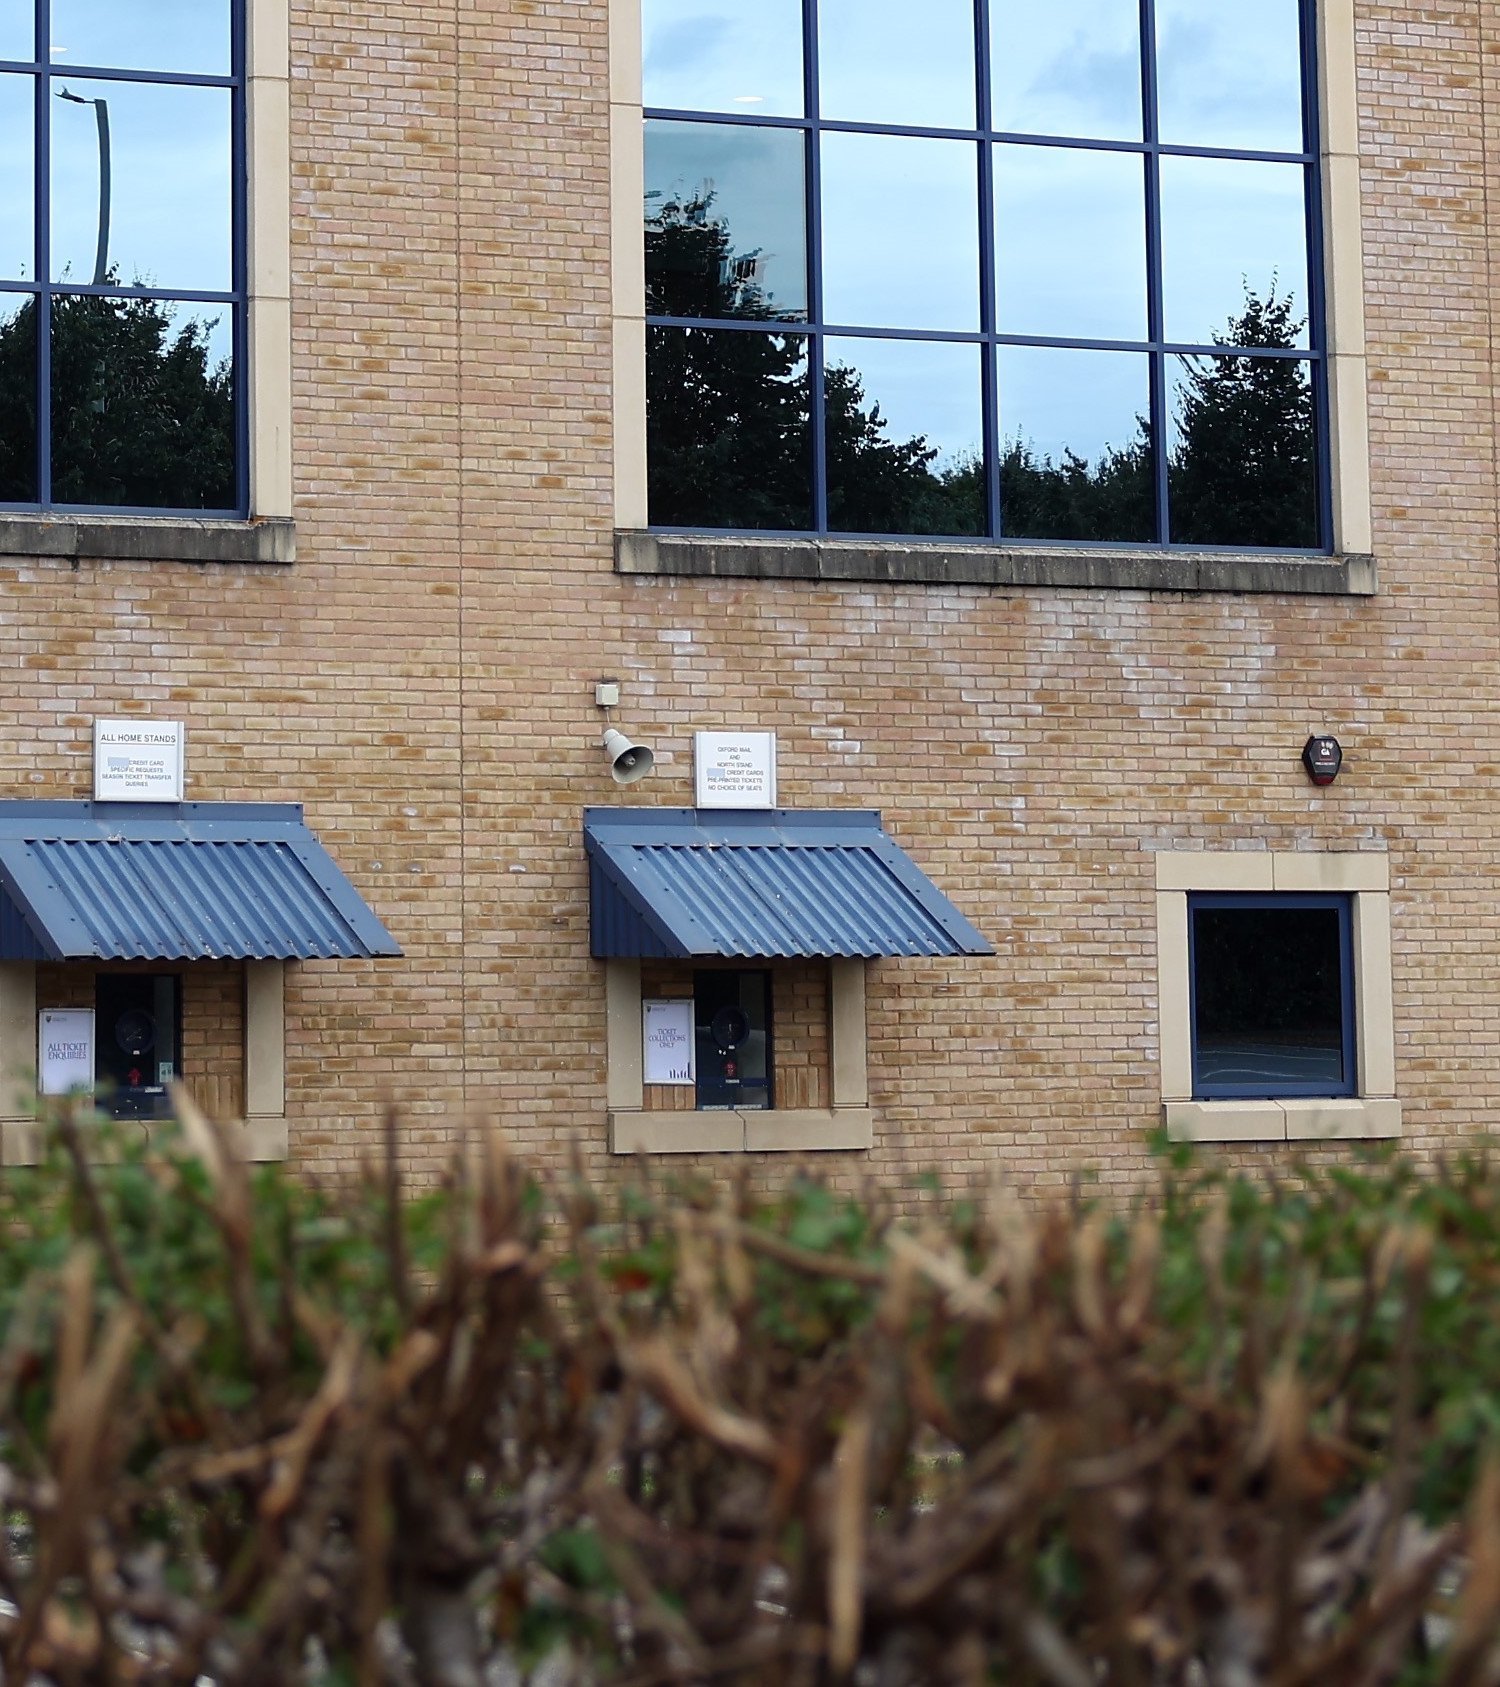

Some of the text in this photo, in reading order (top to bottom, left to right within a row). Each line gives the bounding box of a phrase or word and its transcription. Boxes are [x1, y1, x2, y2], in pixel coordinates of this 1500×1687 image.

[101, 734, 176, 742] ALL HOME STANDS
[48, 1043, 88, 1051] ALL TICKET
[48, 1052, 86, 1060] ENQUIRIES
